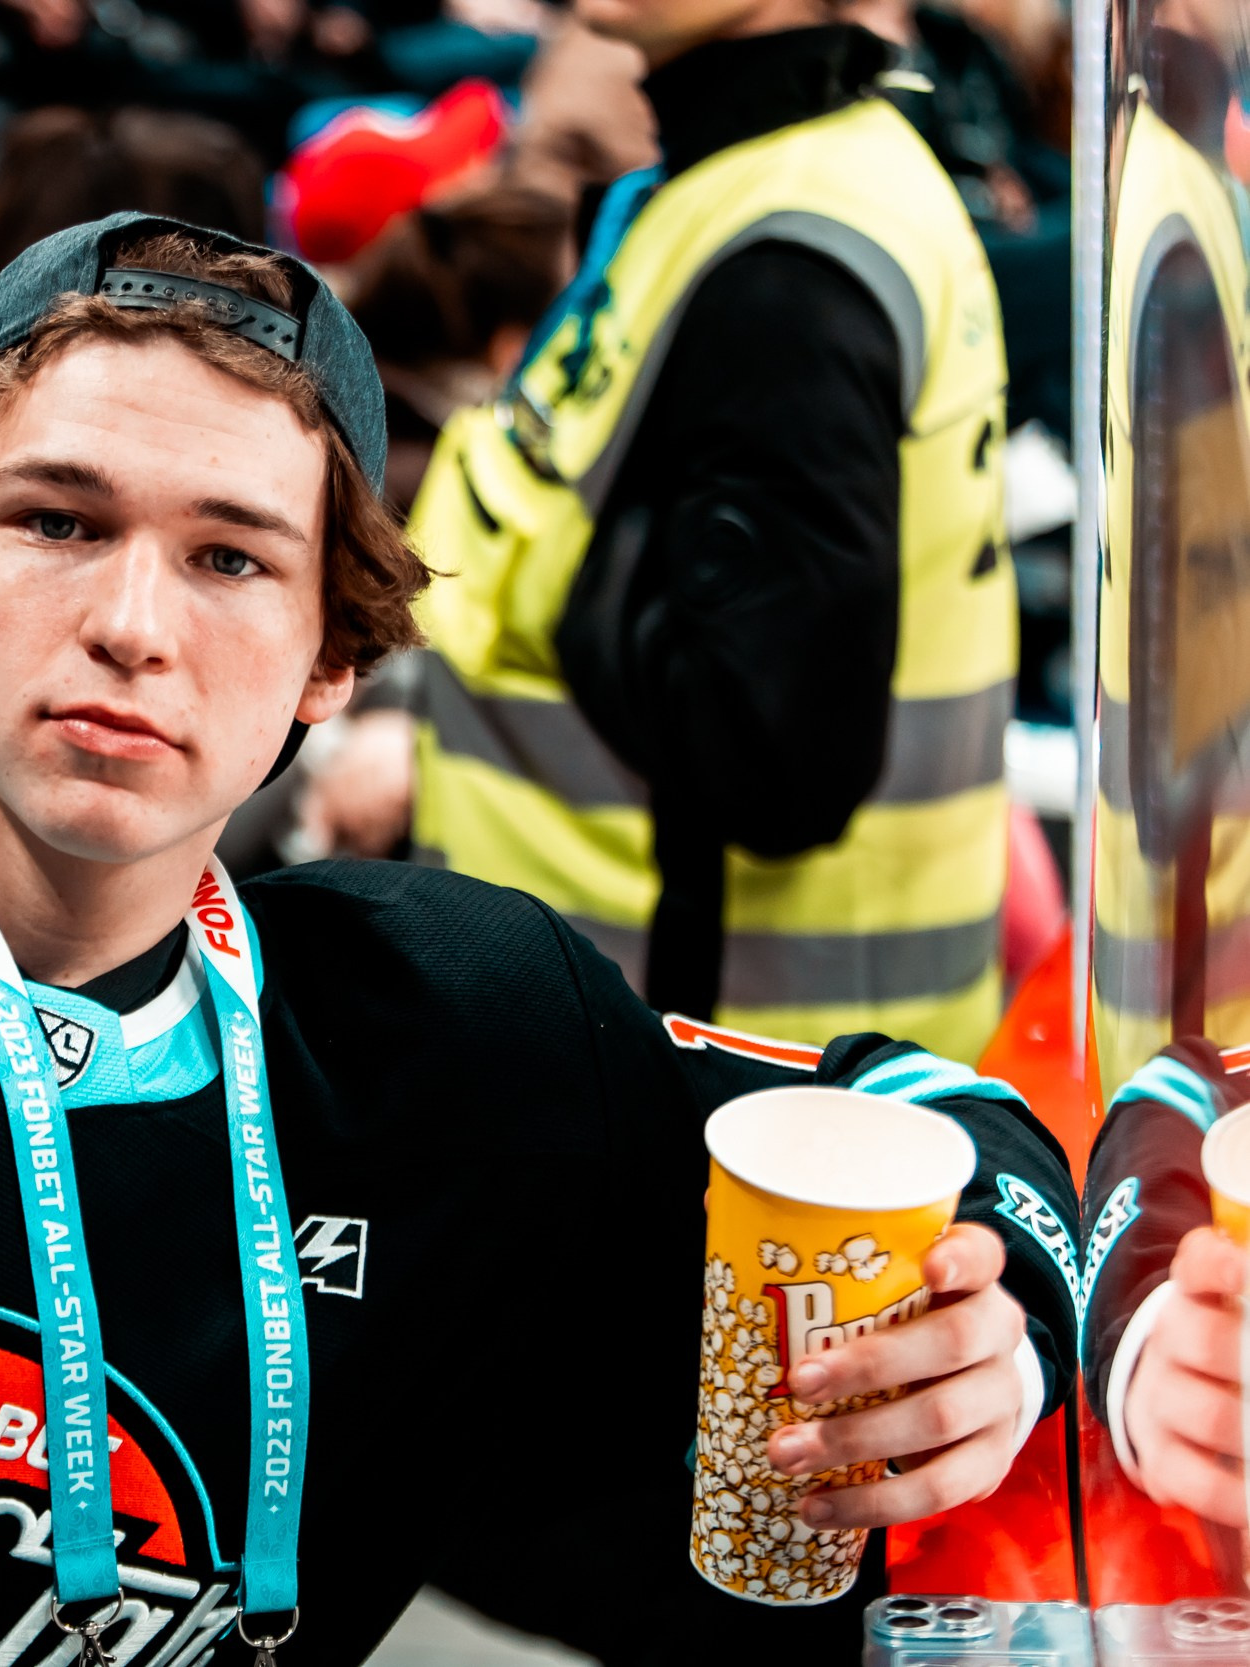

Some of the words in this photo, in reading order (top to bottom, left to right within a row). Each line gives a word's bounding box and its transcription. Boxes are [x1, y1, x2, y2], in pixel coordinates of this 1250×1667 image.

[231, 1025, 263, 1115] WEEK
[17, 1079, 65, 1212] FONBET
[242, 1123, 283, 1274] ALL-STAR
[42, 1218, 89, 1385] ALL-STAR
[258, 1278, 293, 1409] FONBET
[64, 1394, 94, 1495] WEEK
[264, 1418, 291, 1497] 2023
